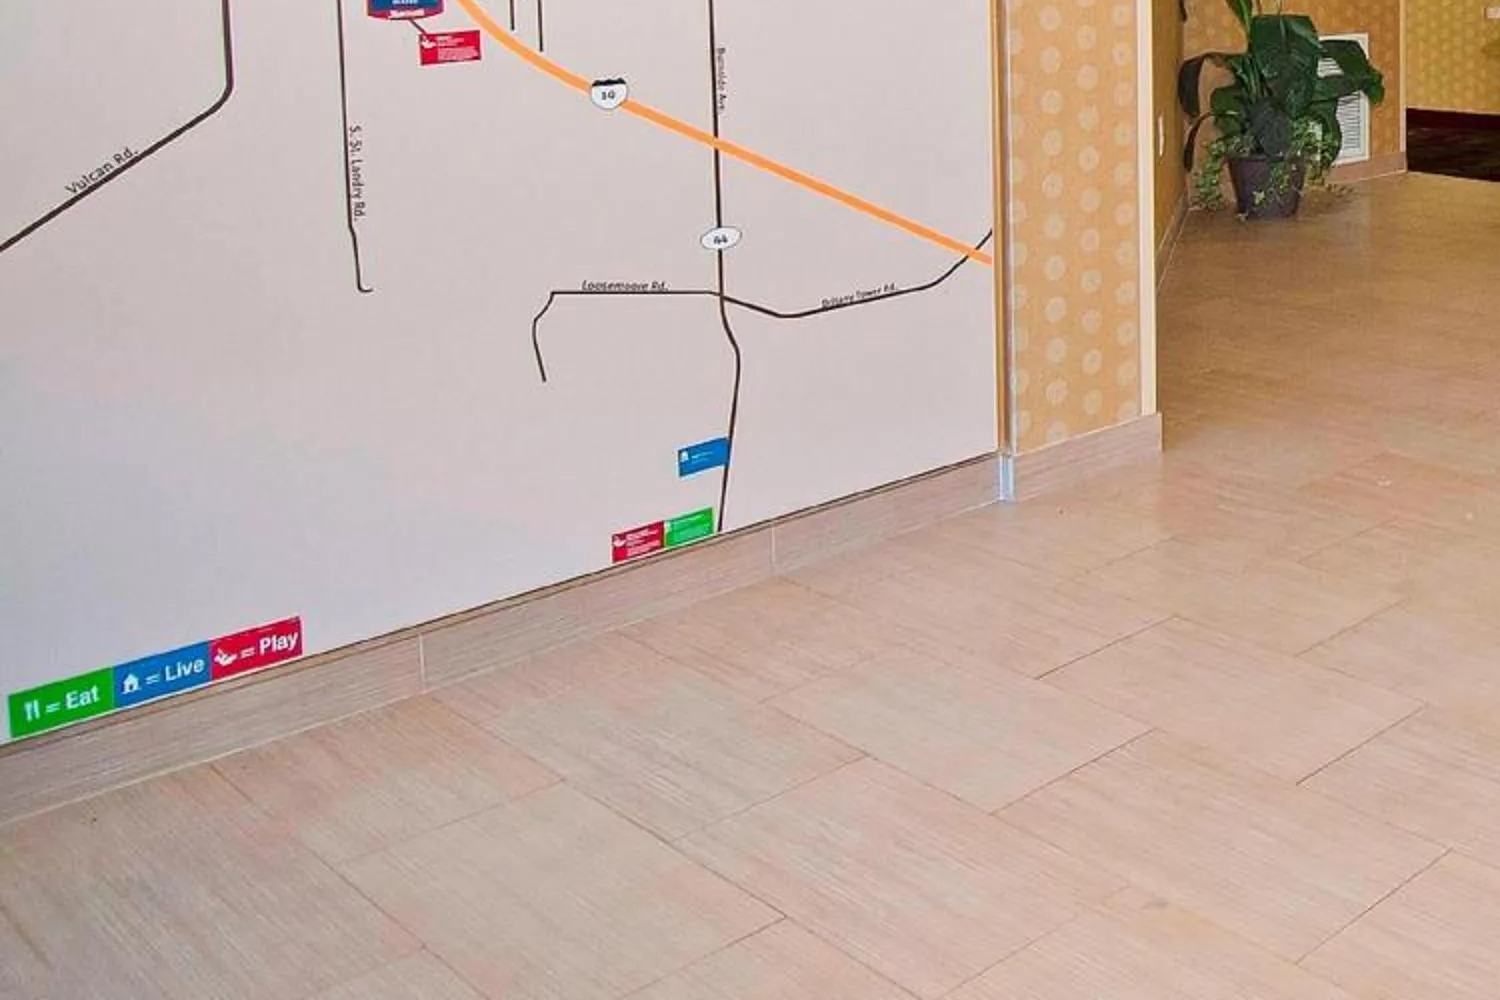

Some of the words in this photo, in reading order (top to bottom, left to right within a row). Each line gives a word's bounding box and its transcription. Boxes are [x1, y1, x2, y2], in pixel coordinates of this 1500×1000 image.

[65, 164, 113, 194] Vulcan
[113, 146, 138, 164] Rd.
[351, 159, 364, 198] Landry
[354, 202, 366, 222] Rd.
[259, 632, 299, 656] Play
[165, 658, 205, 682] Live
[65, 685, 100, 709] Eat
